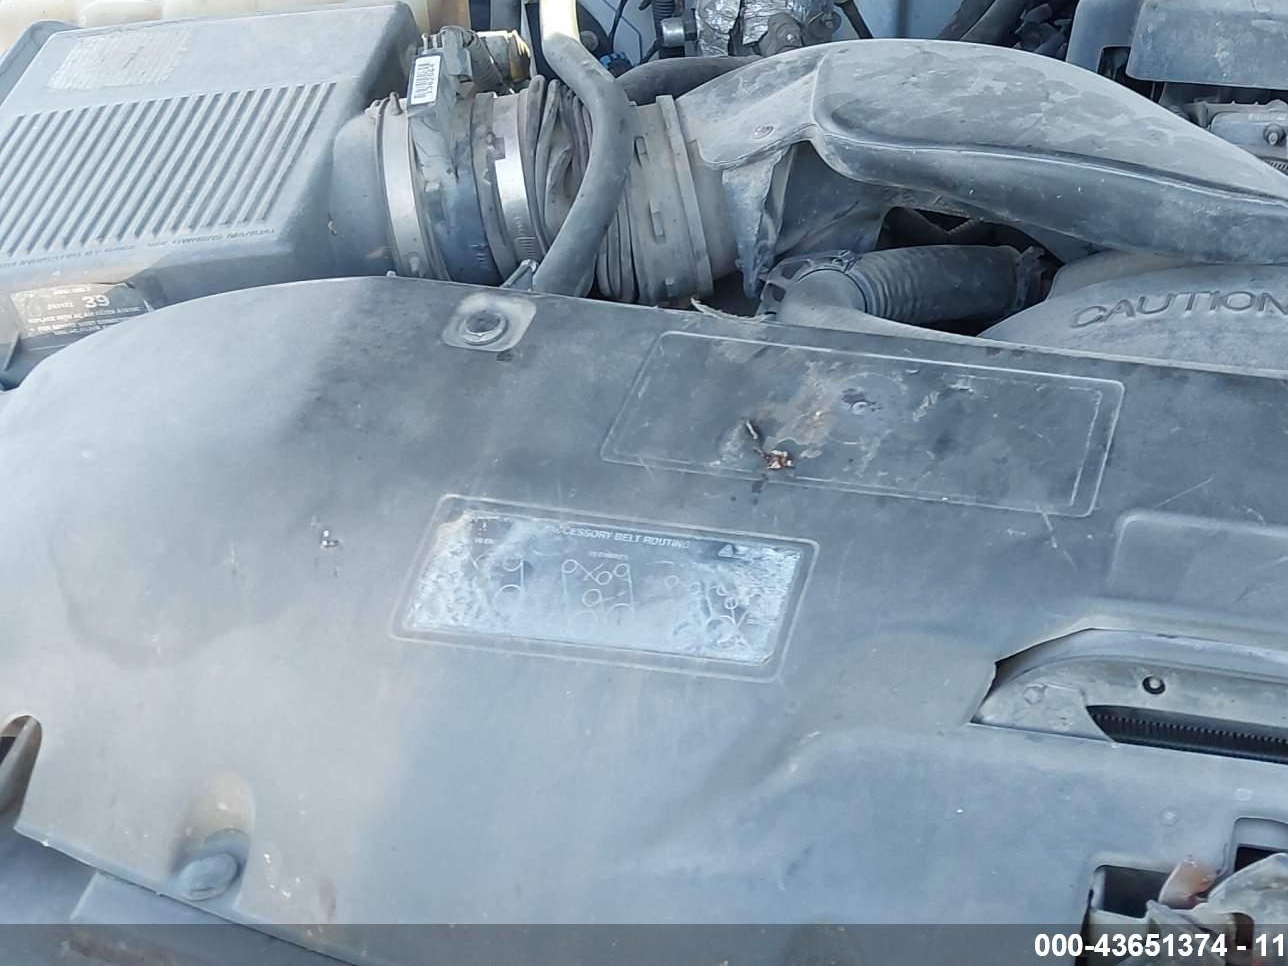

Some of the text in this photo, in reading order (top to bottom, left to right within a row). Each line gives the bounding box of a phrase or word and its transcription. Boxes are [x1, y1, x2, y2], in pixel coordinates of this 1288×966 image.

[82, 294, 111, 309] 39
[551, 526, 691, 550] CESSORY BELT ROUTING
